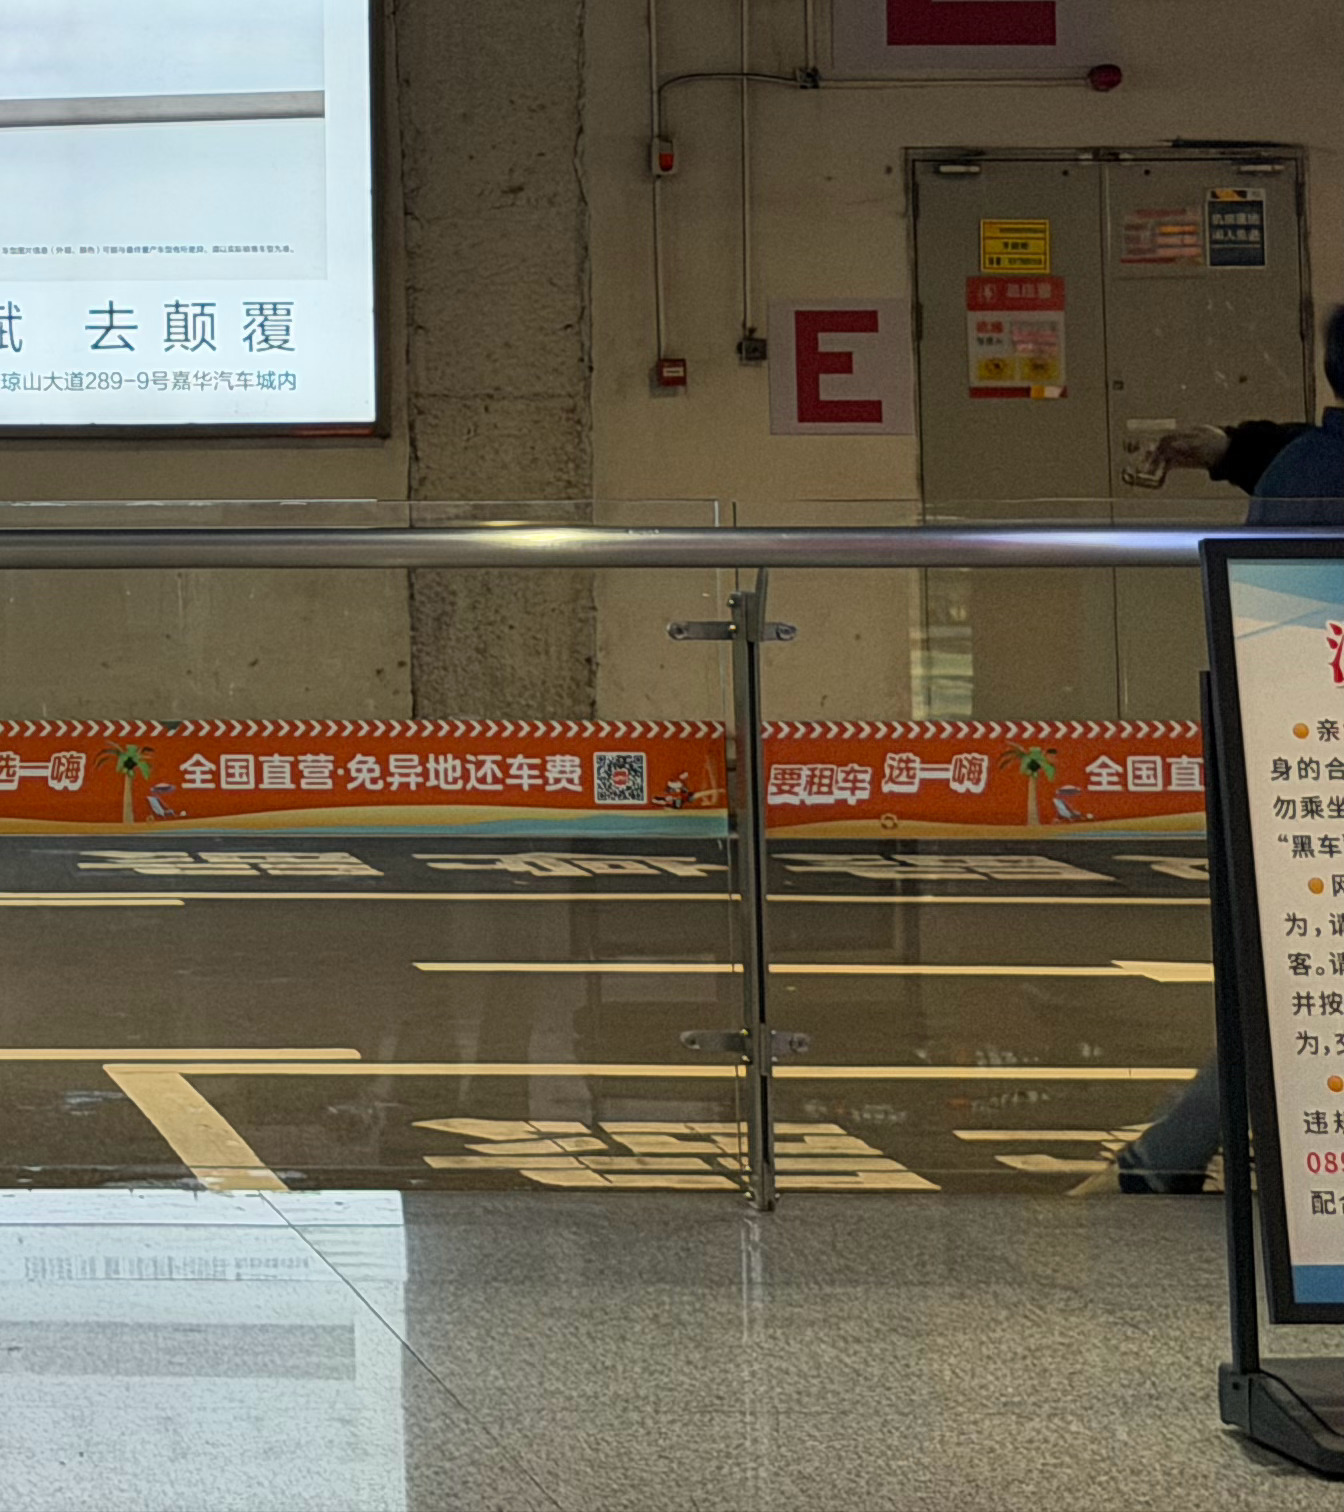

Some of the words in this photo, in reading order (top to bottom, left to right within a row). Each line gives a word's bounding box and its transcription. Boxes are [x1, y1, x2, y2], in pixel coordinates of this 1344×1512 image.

[85, 300, 297, 354] 去颠覆
[795, 310, 883, 423] E
[180, 753, 584, 792] 全国直营·免异地还车费
[768, 763, 872, 805] 要租车
[882, 752, 989, 793] 选一嗨
[1271, 756, 1344, 782] 身的合
[1273, 795, 1344, 820] 勿乘坐
[1278, 834, 1344, 859] “黑车
[1292, 991, 1344, 1016] 并按
[1311, 1190, 1344, 1215] 配
